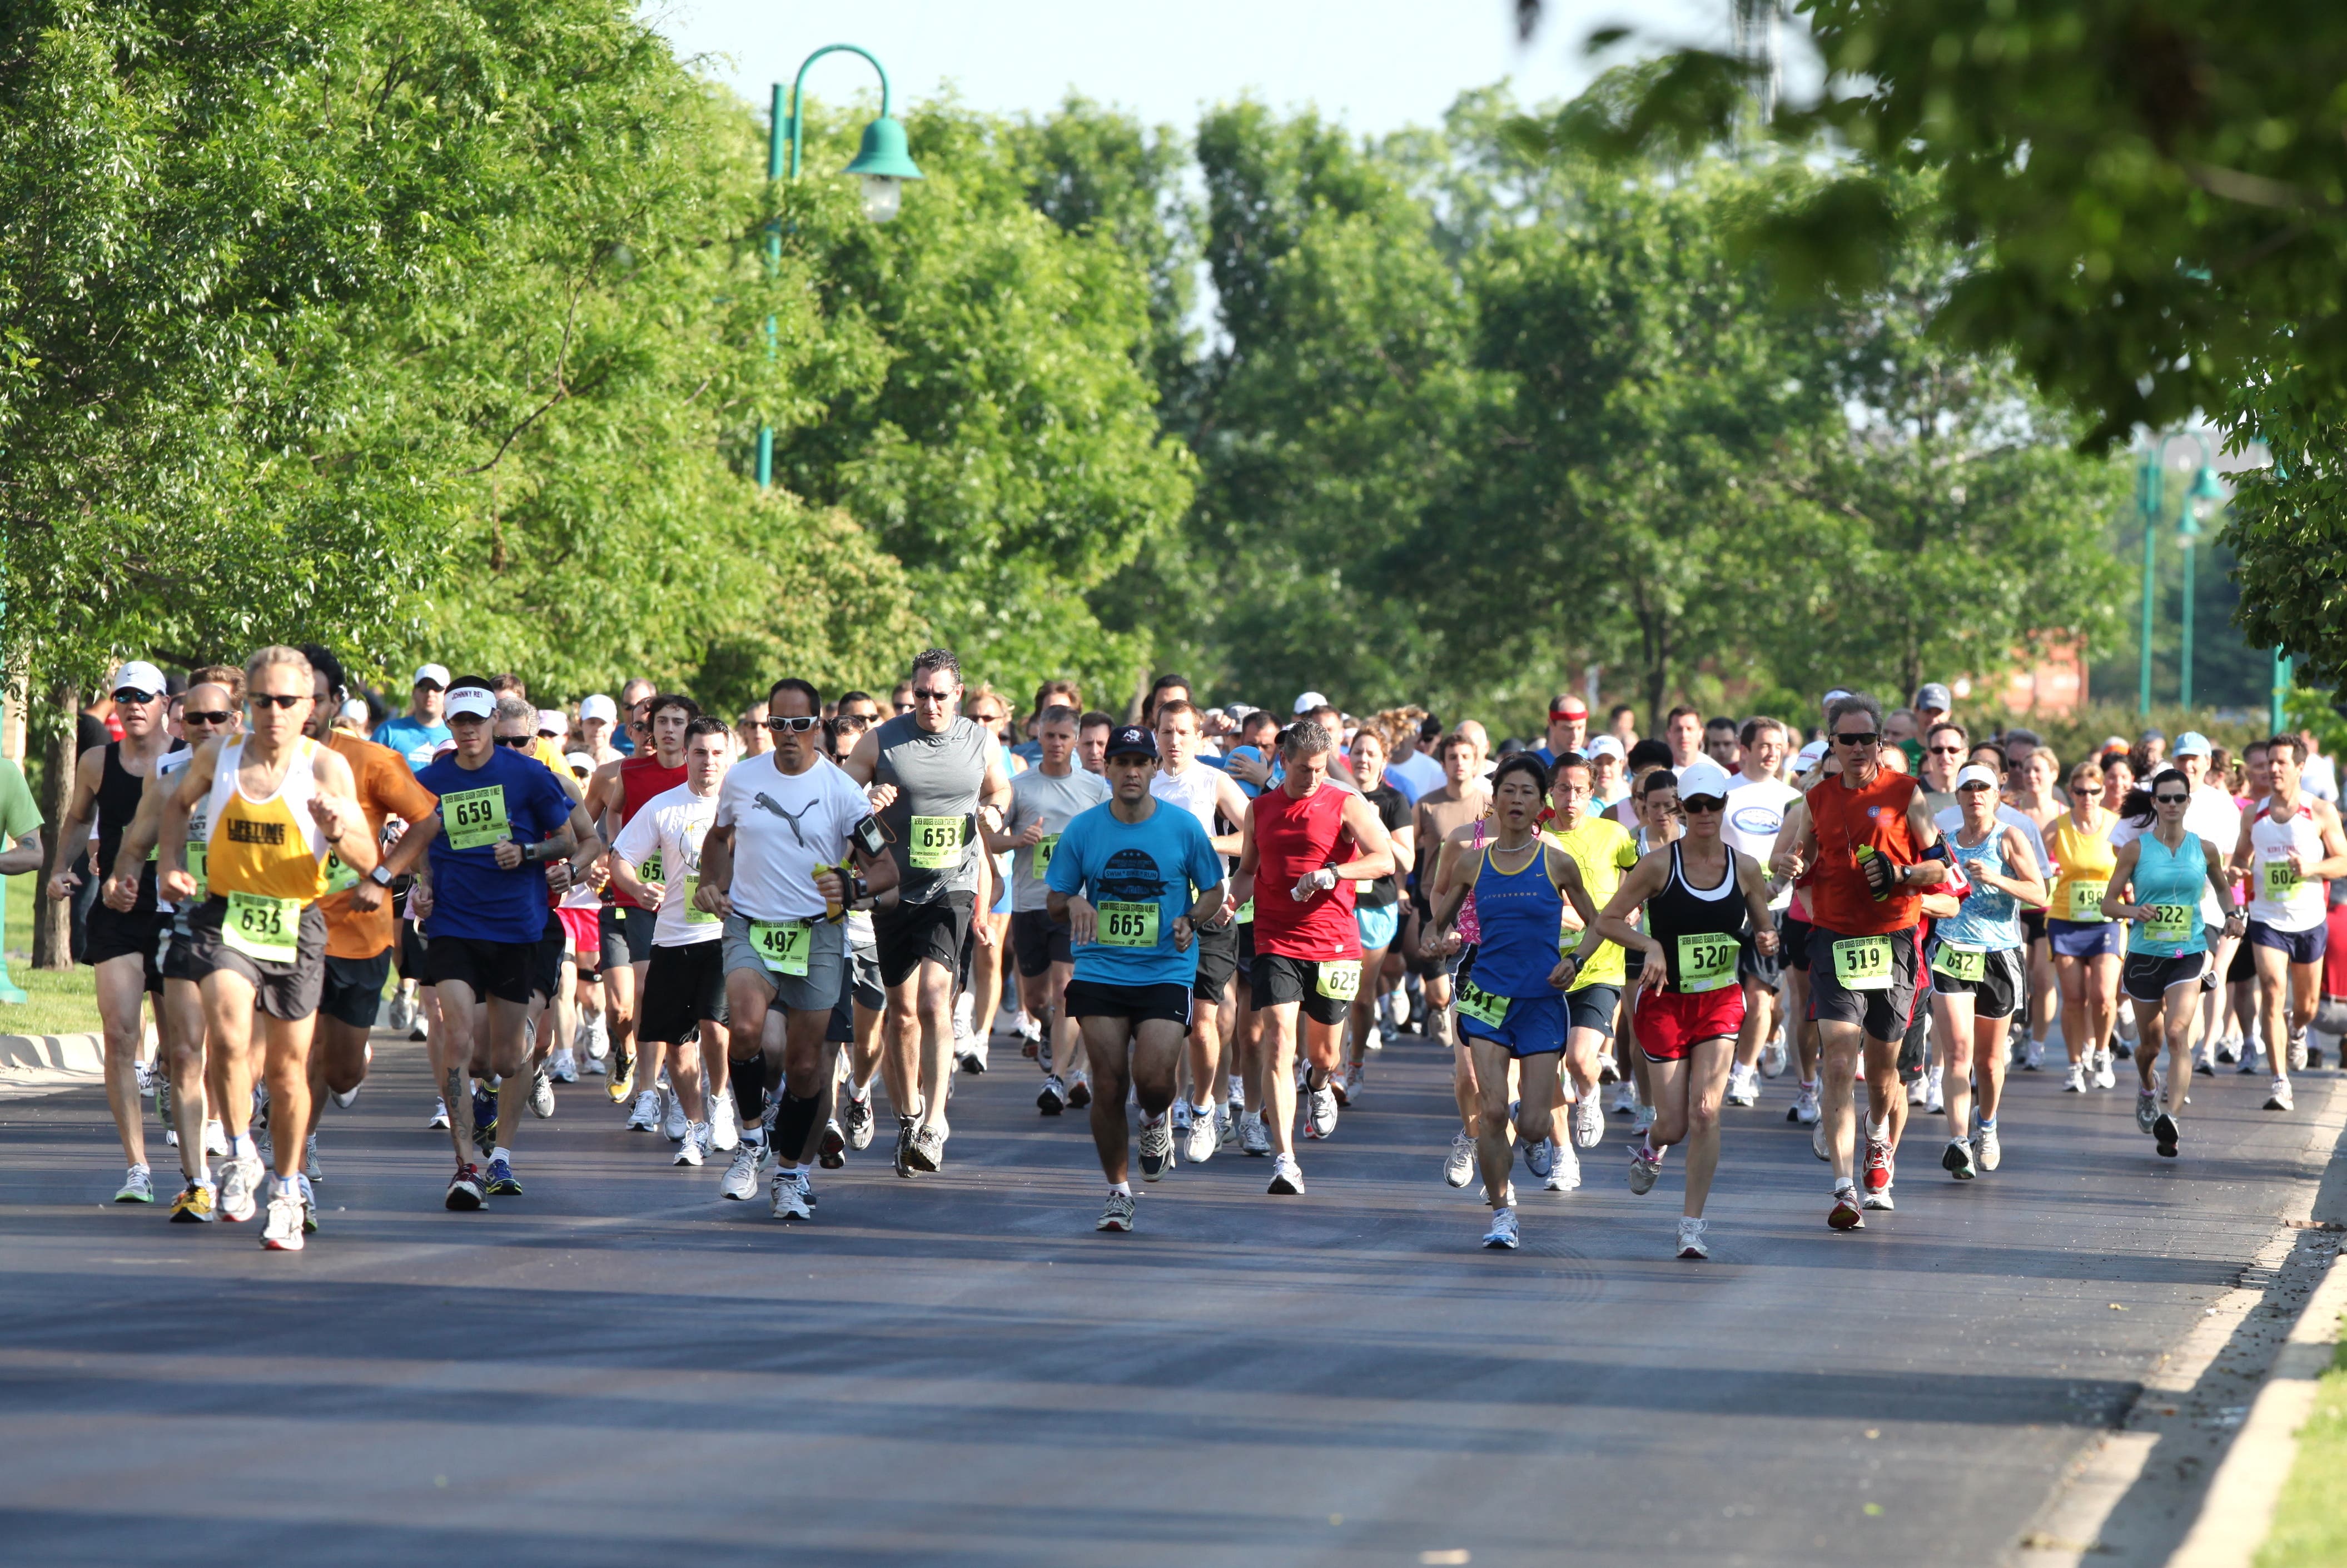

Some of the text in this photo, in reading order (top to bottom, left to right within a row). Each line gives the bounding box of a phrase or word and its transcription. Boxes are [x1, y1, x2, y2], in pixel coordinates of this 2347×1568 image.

[457, 800, 492, 825] 659
[227, 818, 285, 835] LIFETIME
[923, 828, 956, 847] 653
[642, 862, 665, 880] 65
[2078, 890, 2102, 905] 498
[242, 909, 280, 934] 635
[2155, 906, 2183, 923] 622
[1110, 914, 1144, 937] 665
[763, 931, 798, 952] 497
[1693, 945, 1728, 969] 520
[1847, 948, 1879, 970] 519
[1946, 952, 1973, 972] 632
[1459, 988, 1494, 1013] 641
